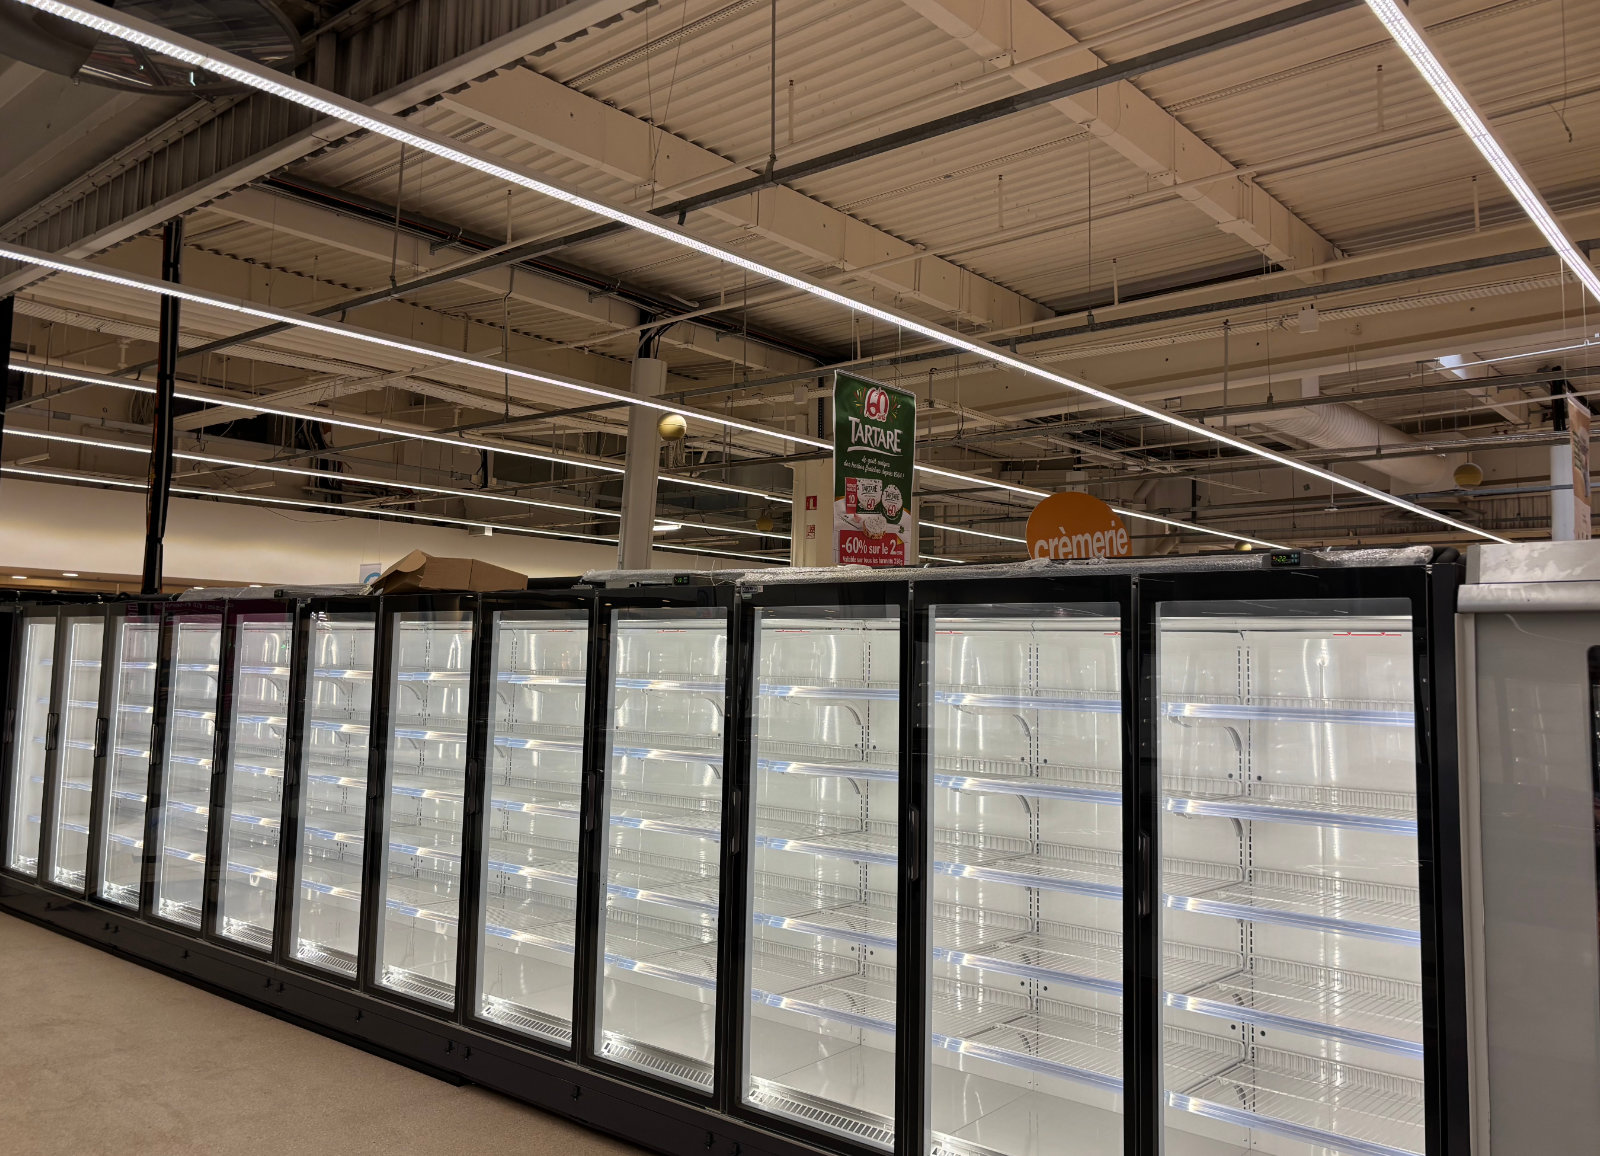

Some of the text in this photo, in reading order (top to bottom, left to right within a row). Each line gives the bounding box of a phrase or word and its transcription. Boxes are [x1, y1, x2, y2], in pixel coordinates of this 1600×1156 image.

[848, 416, 903, 453] TARTARE
[841, 536, 867, 554] -60%
[868, 545, 880, 554] sur
[881, 543, 889, 555] le
[1034, 520, 1128, 559] crèmerie
